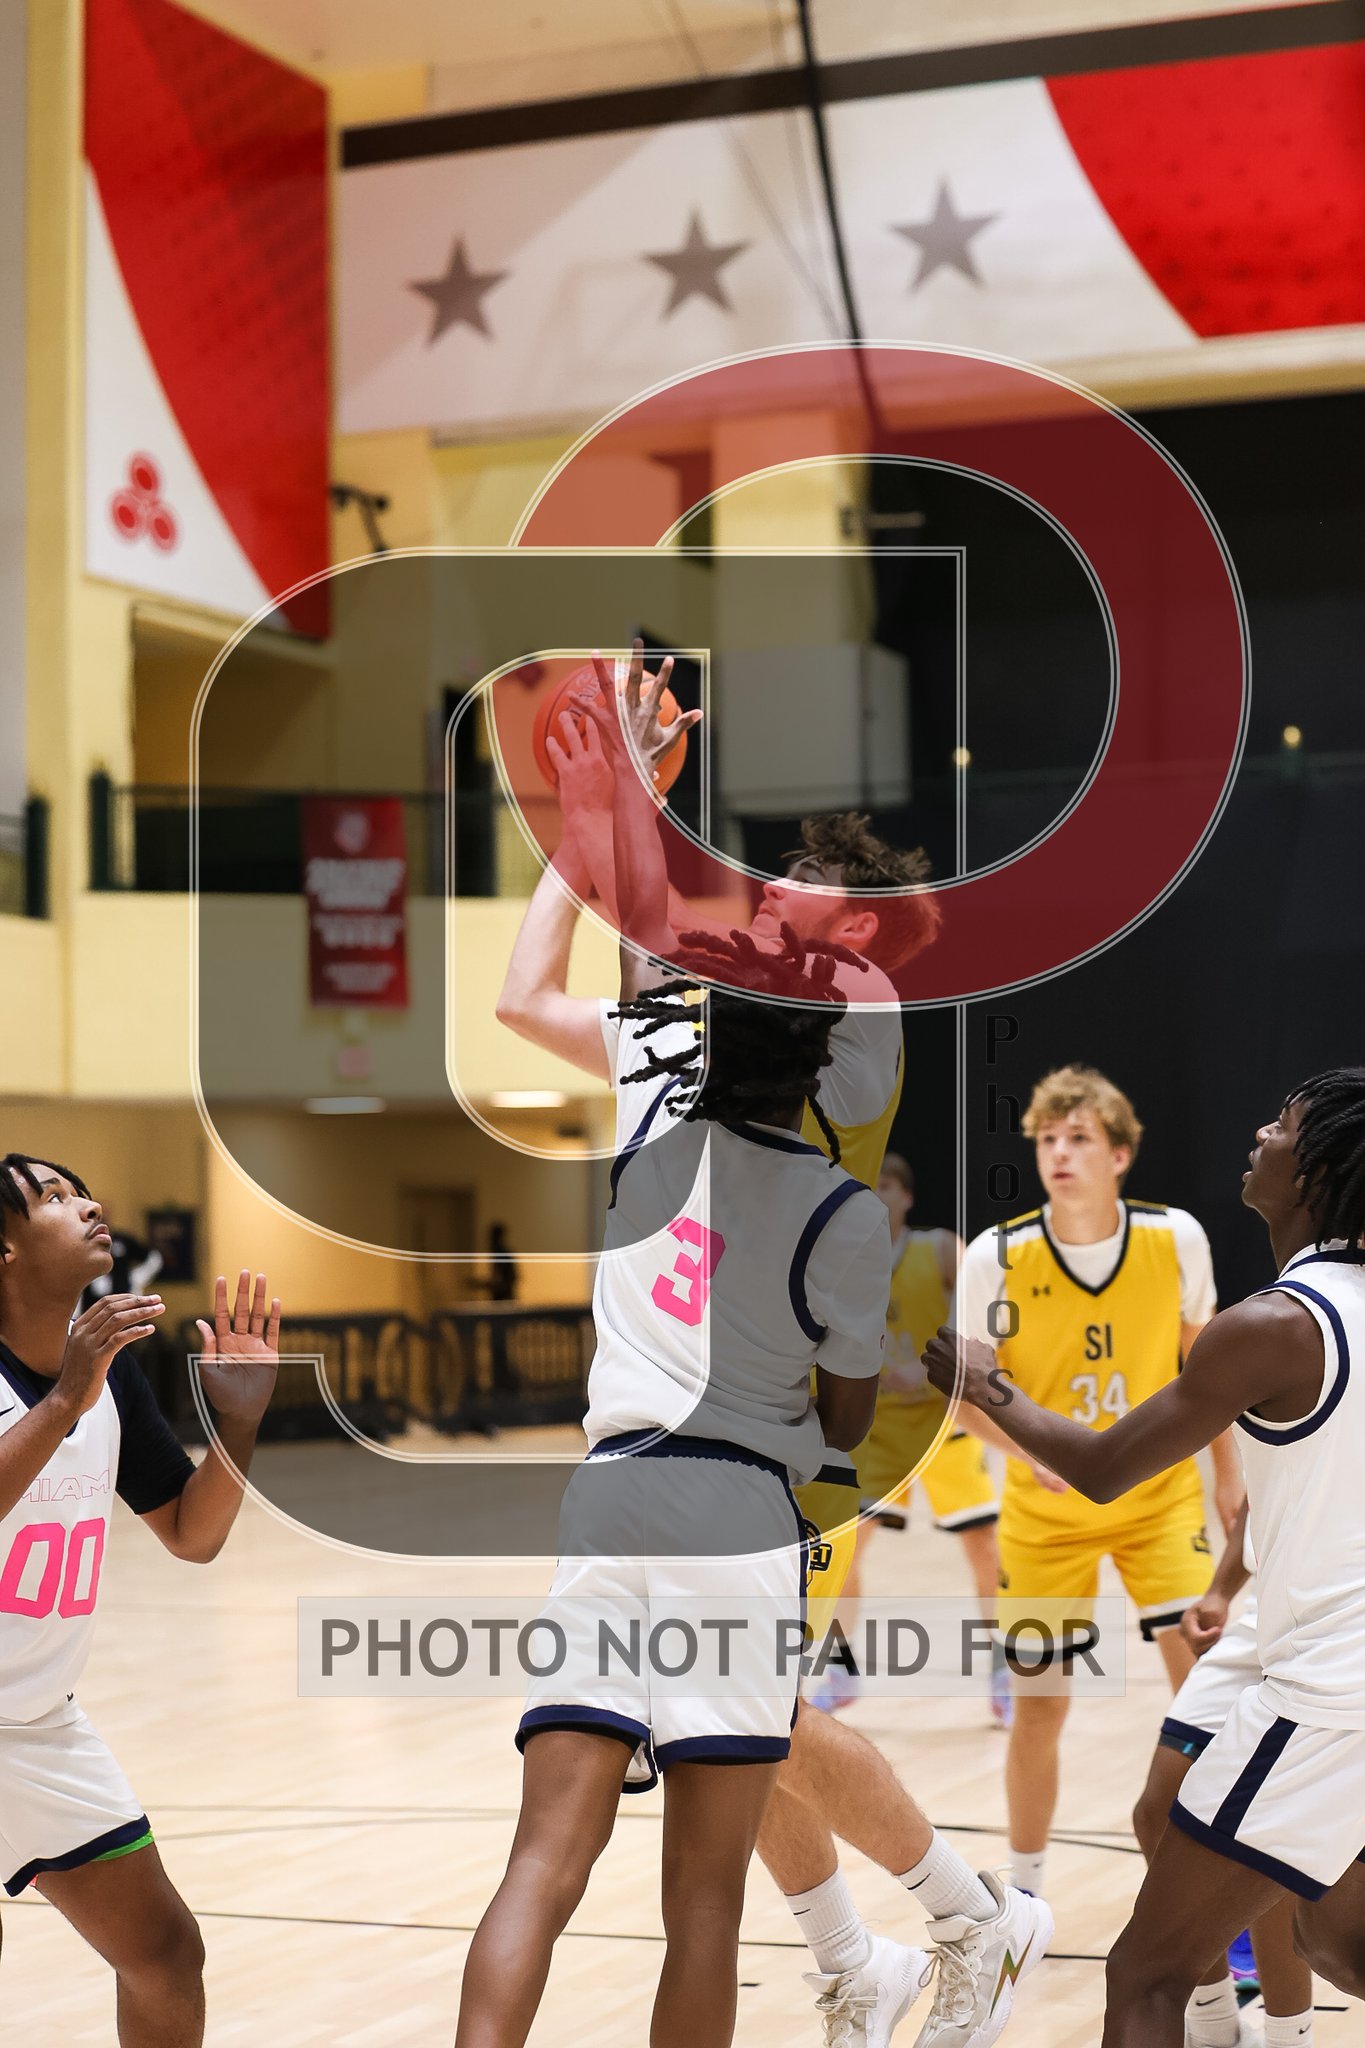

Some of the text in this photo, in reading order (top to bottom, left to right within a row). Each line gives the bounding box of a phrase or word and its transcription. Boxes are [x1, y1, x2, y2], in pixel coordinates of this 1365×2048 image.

[651, 1216, 726, 1327] 3
[1085, 1323, 1113, 1360] SI
[1070, 1371, 1130, 1424] 34
[0, 1517, 106, 1619] 00
